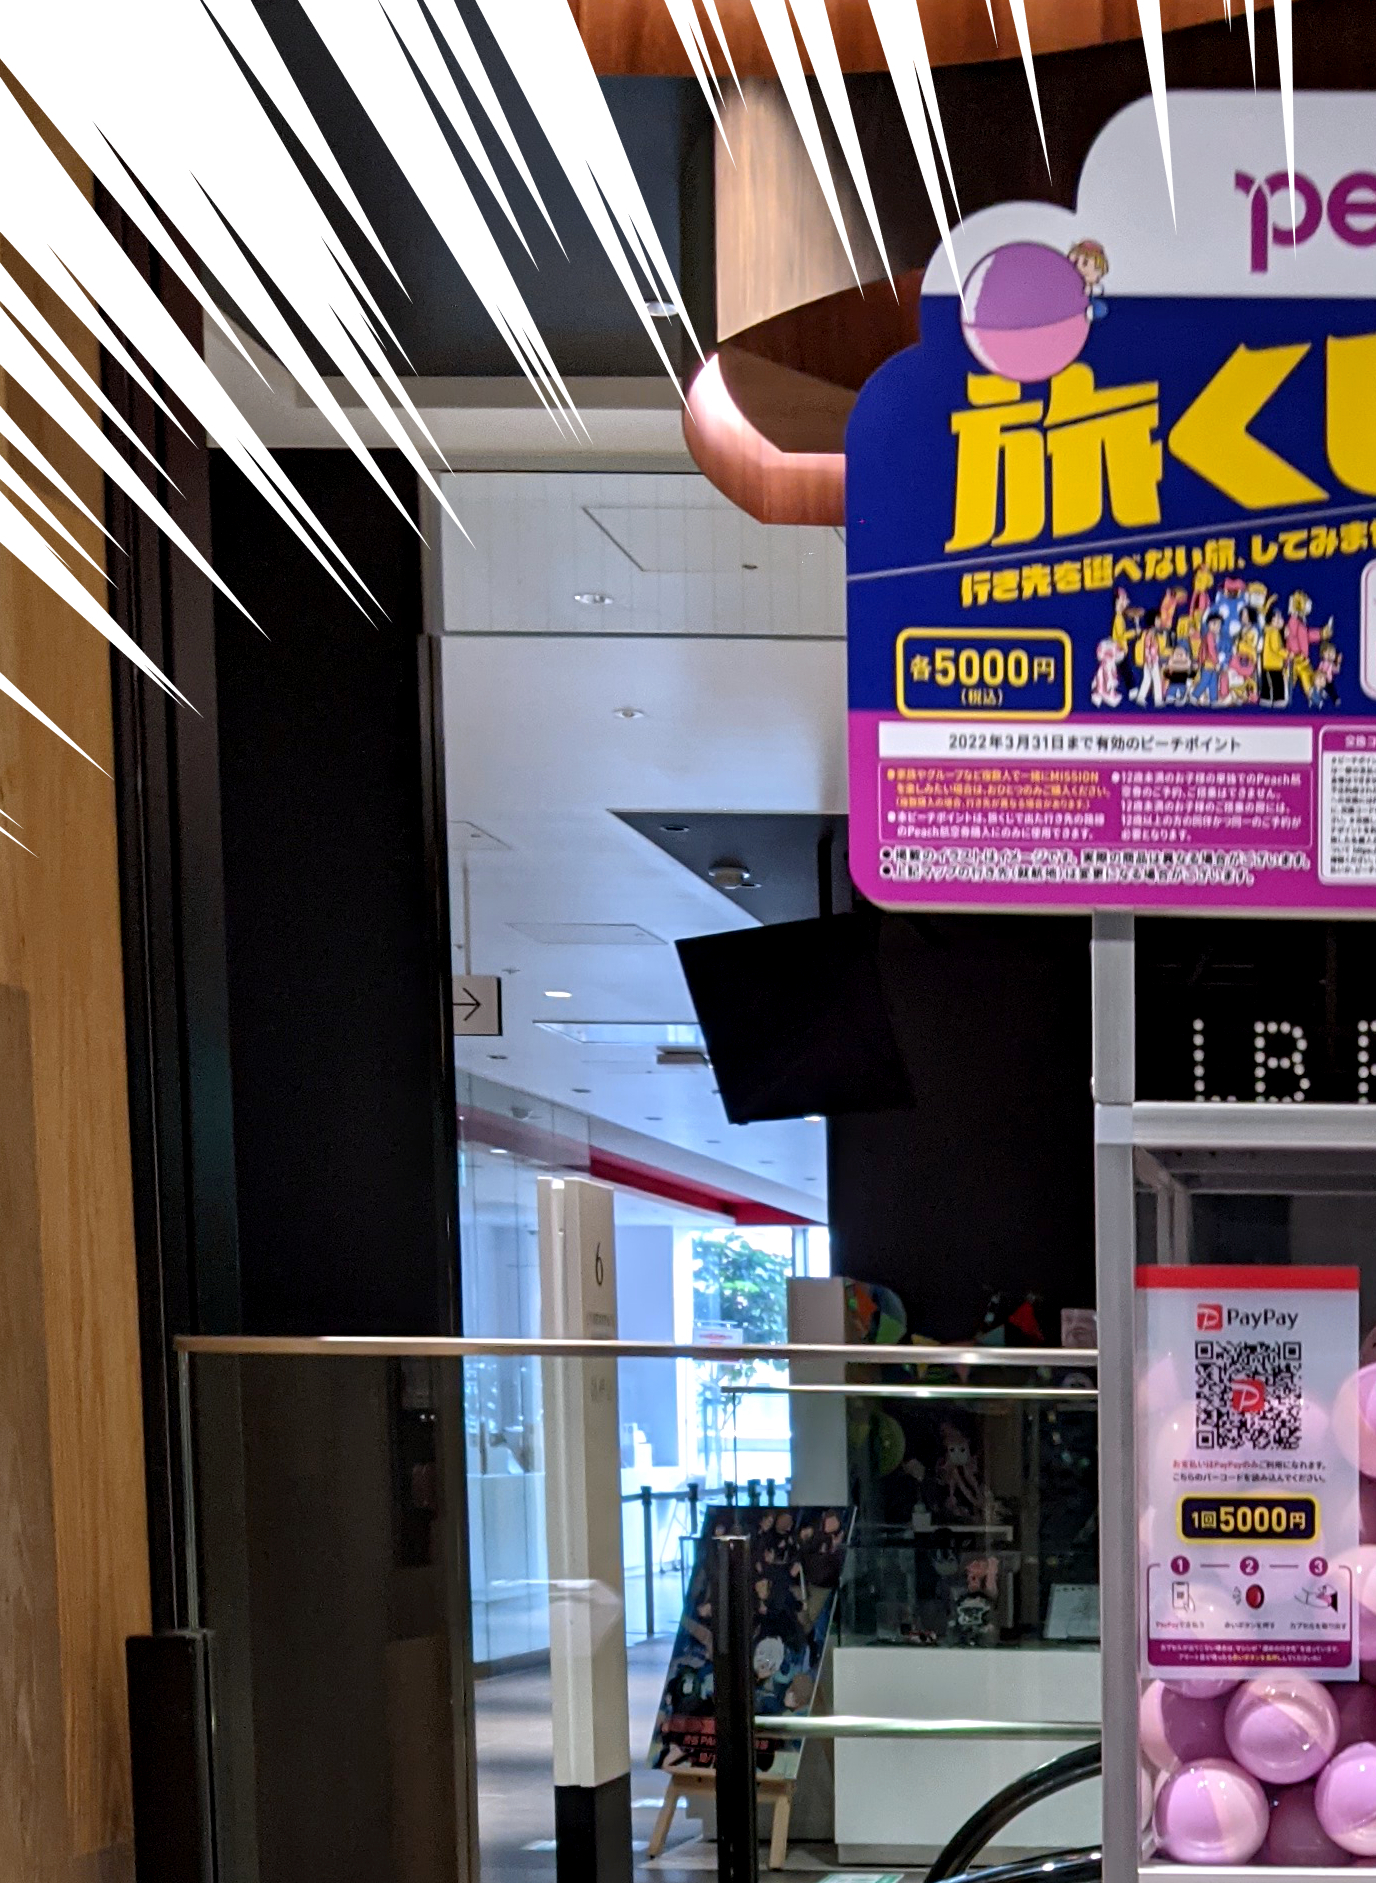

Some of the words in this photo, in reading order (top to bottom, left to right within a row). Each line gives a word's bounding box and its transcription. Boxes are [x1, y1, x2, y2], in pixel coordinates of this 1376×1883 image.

[909, 649, 1056, 687] 各5000円
[949, 733, 1241, 753] 2022年3月31日まで有効のピーチポイント
[1194, 1018, 1310, 1103] LB
[594, 1241, 605, 1287] 6
[1227, 1307, 1299, 1330] PayPay
[1191, 1505, 1306, 1534] 1回5000円
